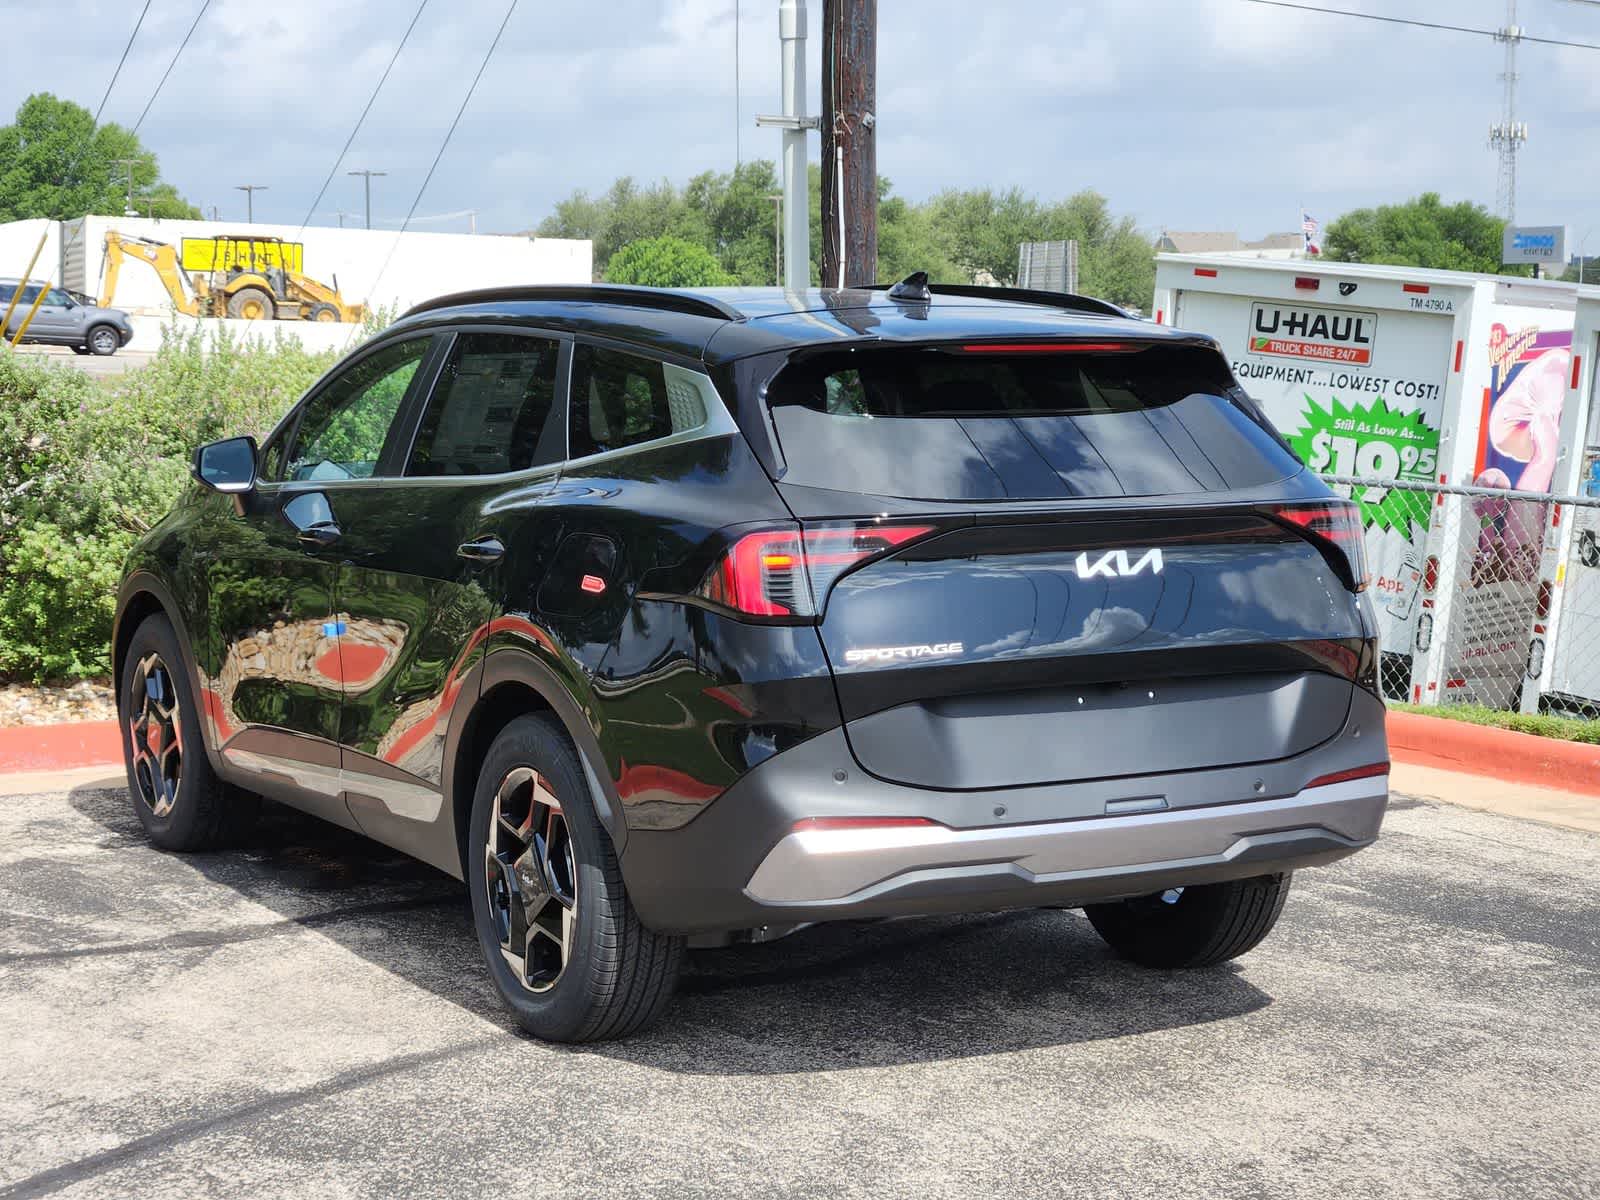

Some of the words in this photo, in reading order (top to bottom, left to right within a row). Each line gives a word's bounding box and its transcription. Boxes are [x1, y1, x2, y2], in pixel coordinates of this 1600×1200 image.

[1410, 297, 1423, 309] TM
[1446, 300, 1453, 311] A
[1270, 341, 1302, 354] TRUCK
[1303, 344, 1335, 358] SHARE
[1336, 348, 1357, 360] 24/7
[1394, 380, 1440, 400] COST!
[1334, 416, 1356, 432] Still
[1356, 421, 1371, 434] As
[1374, 423, 1398, 437] Low
[1075, 548, 1164, 578] KIA
[845, 642, 964, 662] SPORTAGE
